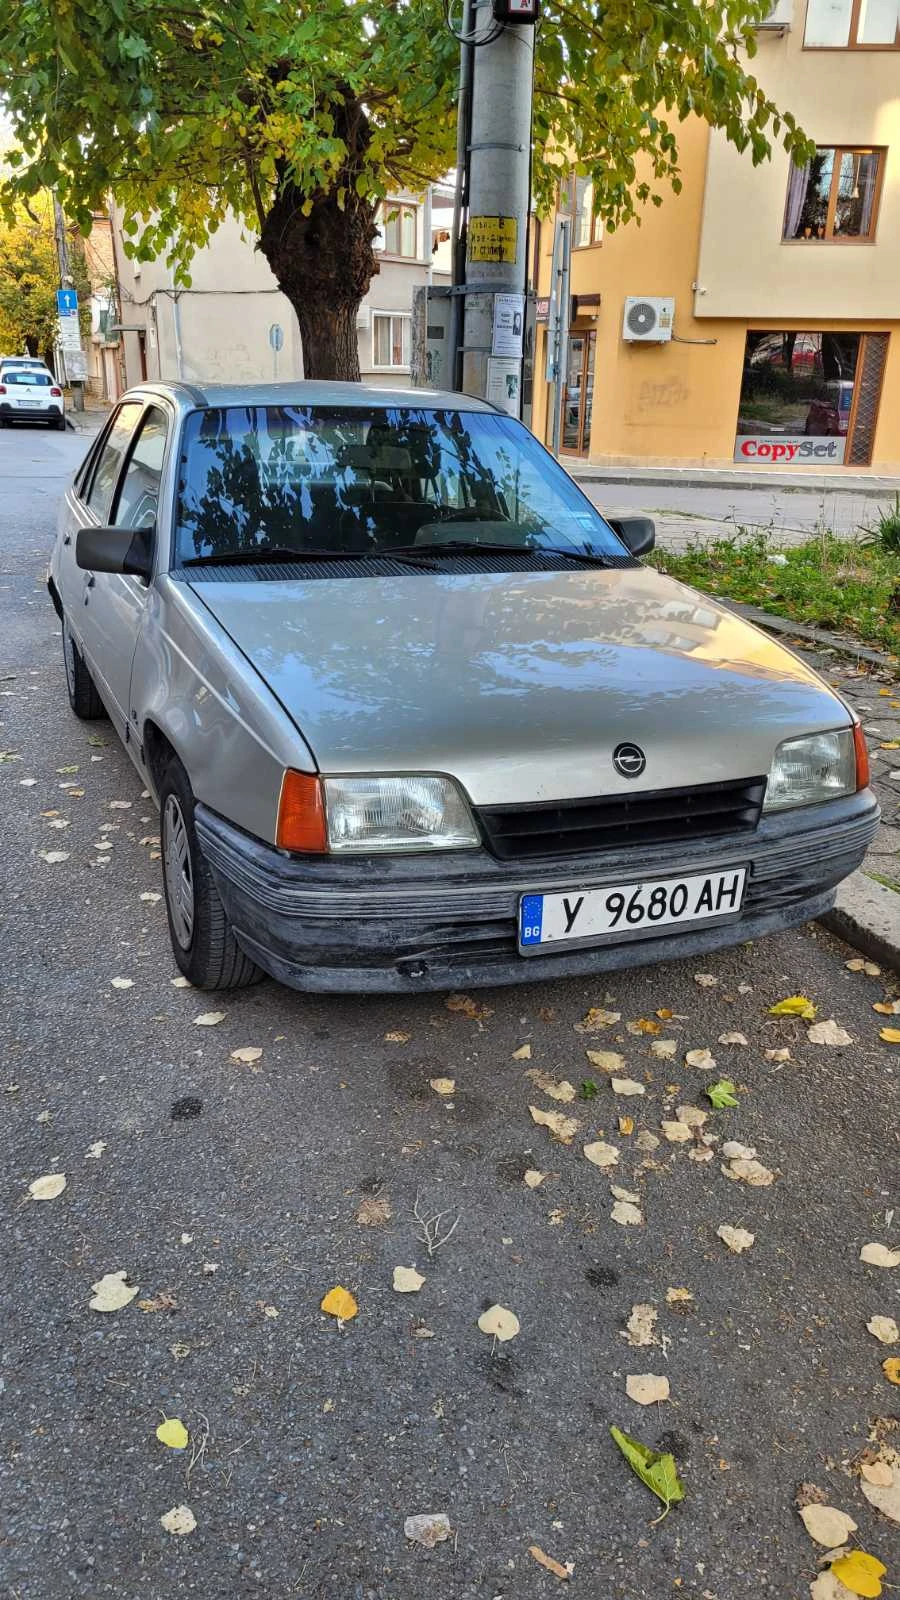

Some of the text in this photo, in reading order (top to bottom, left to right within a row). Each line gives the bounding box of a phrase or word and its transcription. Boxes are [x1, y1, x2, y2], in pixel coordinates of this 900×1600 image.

[741, 440, 837, 461] CopySet
[605, 884, 689, 928] 9680
[694, 874, 739, 914] AH
[524, 926, 540, 938] BG
